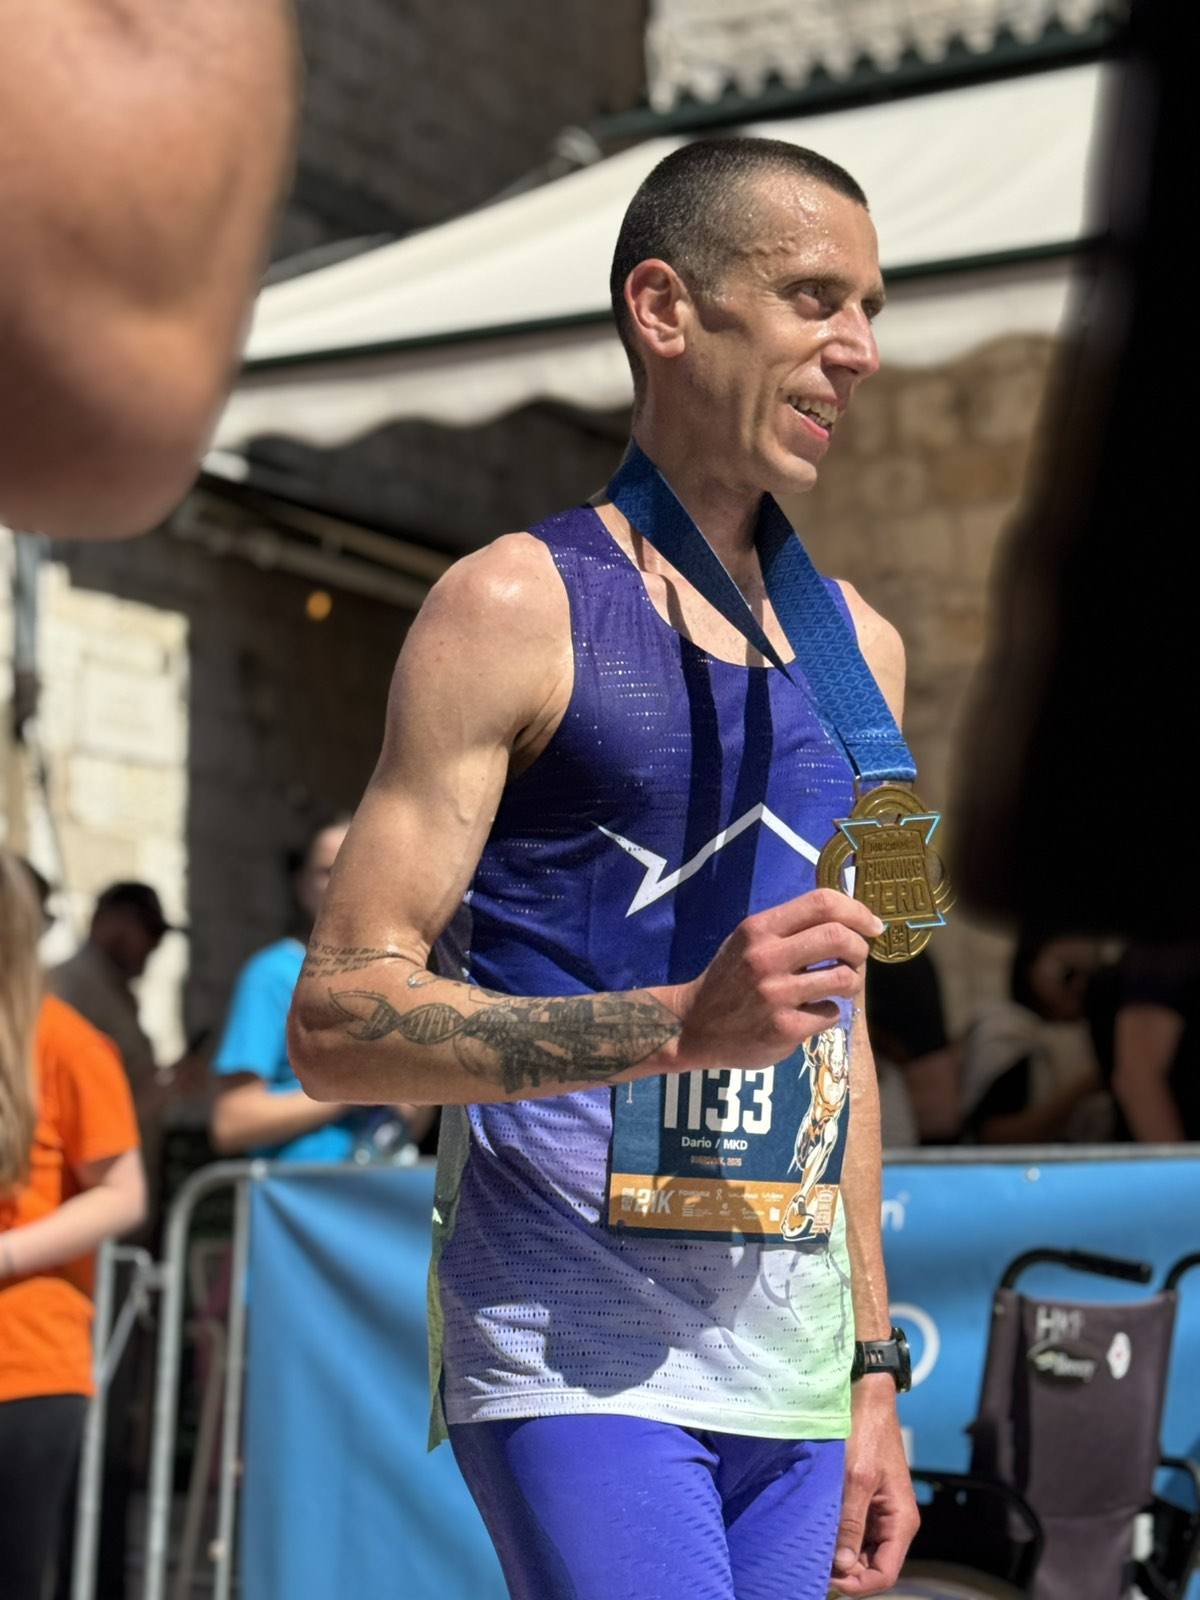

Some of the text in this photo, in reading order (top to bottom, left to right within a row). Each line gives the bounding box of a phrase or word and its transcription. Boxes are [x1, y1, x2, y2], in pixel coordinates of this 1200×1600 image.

[864, 876, 928, 915] HERO
[664, 1064, 775, 1135] 1133
[681, 1136, 712, 1149] Dario
[723, 1138, 748, 1151] MKD
